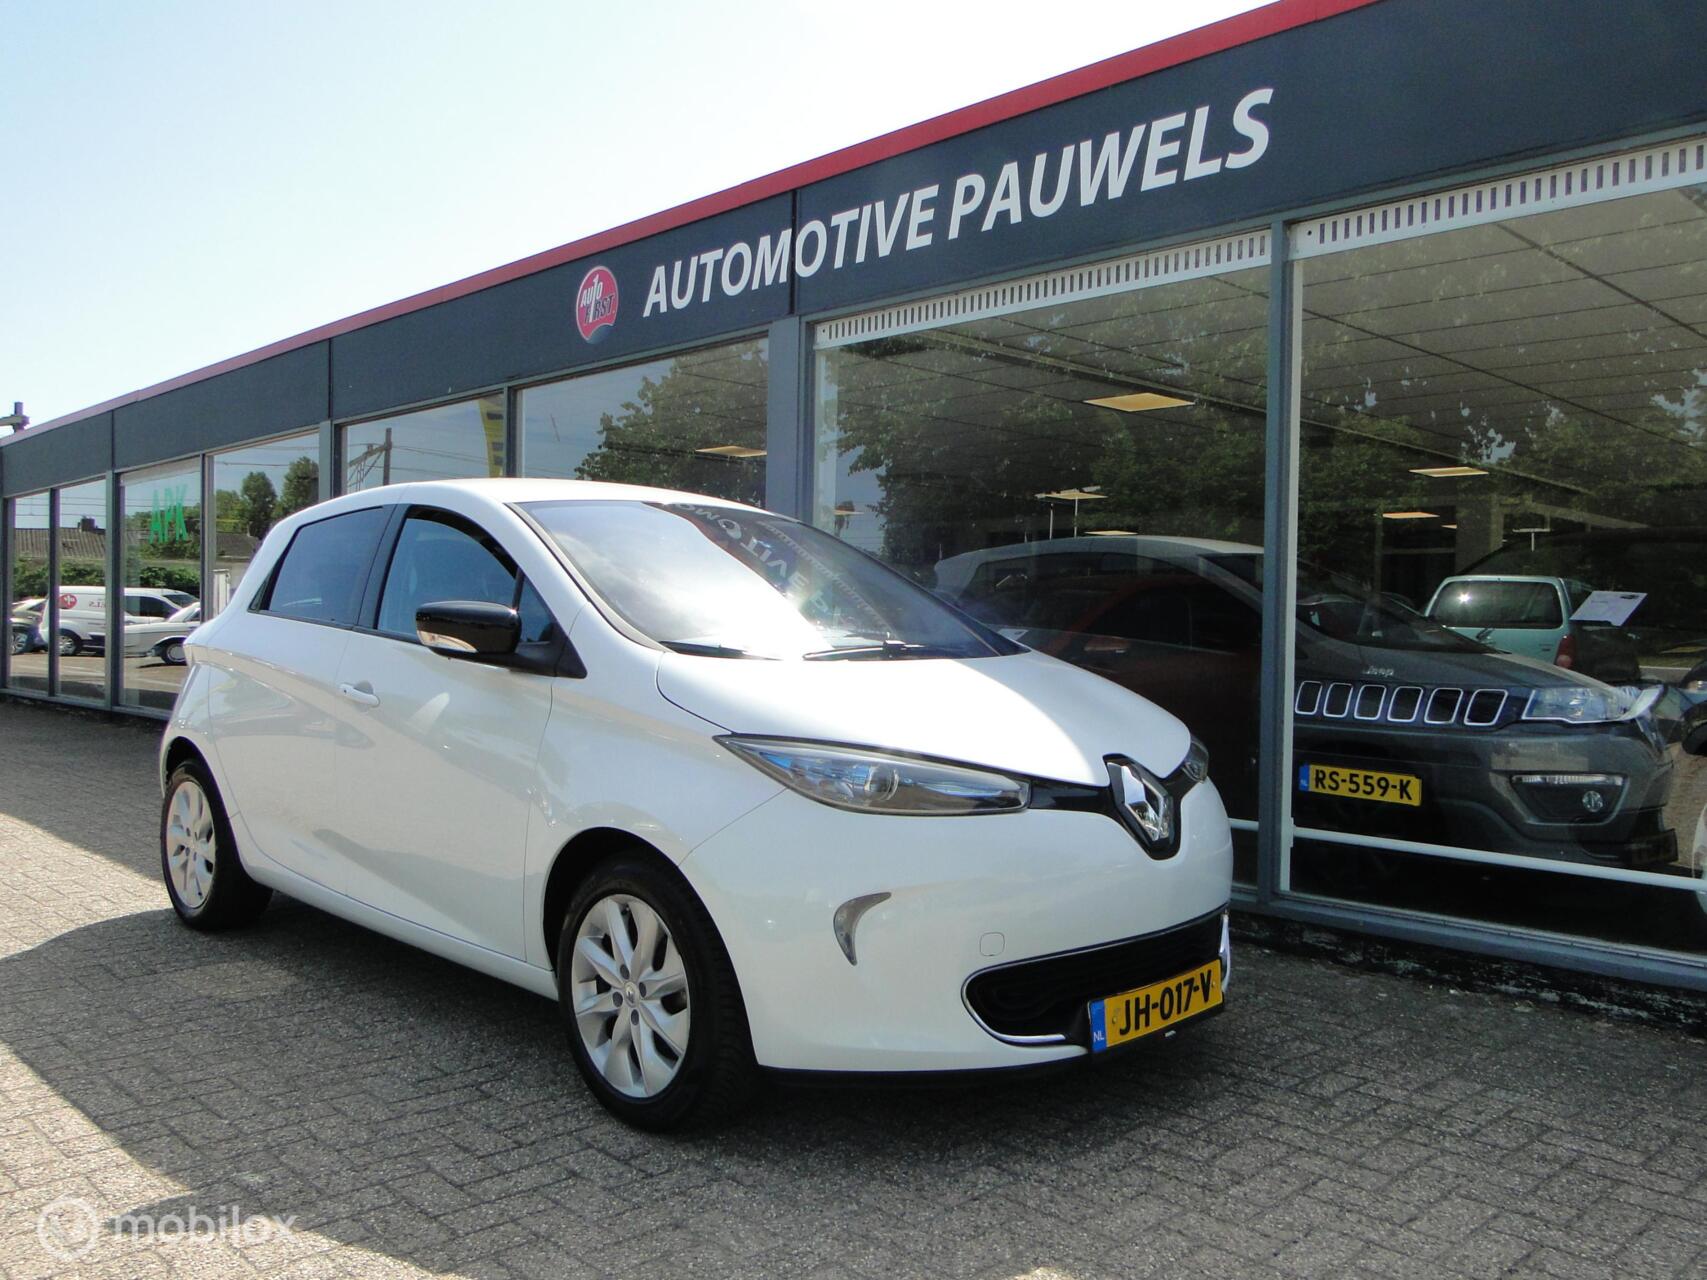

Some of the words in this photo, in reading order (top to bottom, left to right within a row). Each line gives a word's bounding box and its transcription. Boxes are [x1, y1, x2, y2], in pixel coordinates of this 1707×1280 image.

[642, 184, 940, 318] AUTOMOTIVE
[948, 88, 1274, 241] PAUWELS
[1362, 665, 1394, 678] Jeep
[1315, 769, 1413, 801] RS-559-K
[1093, 1030, 1105, 1043] NL
[1119, 969, 1212, 1036] JH-017-V
